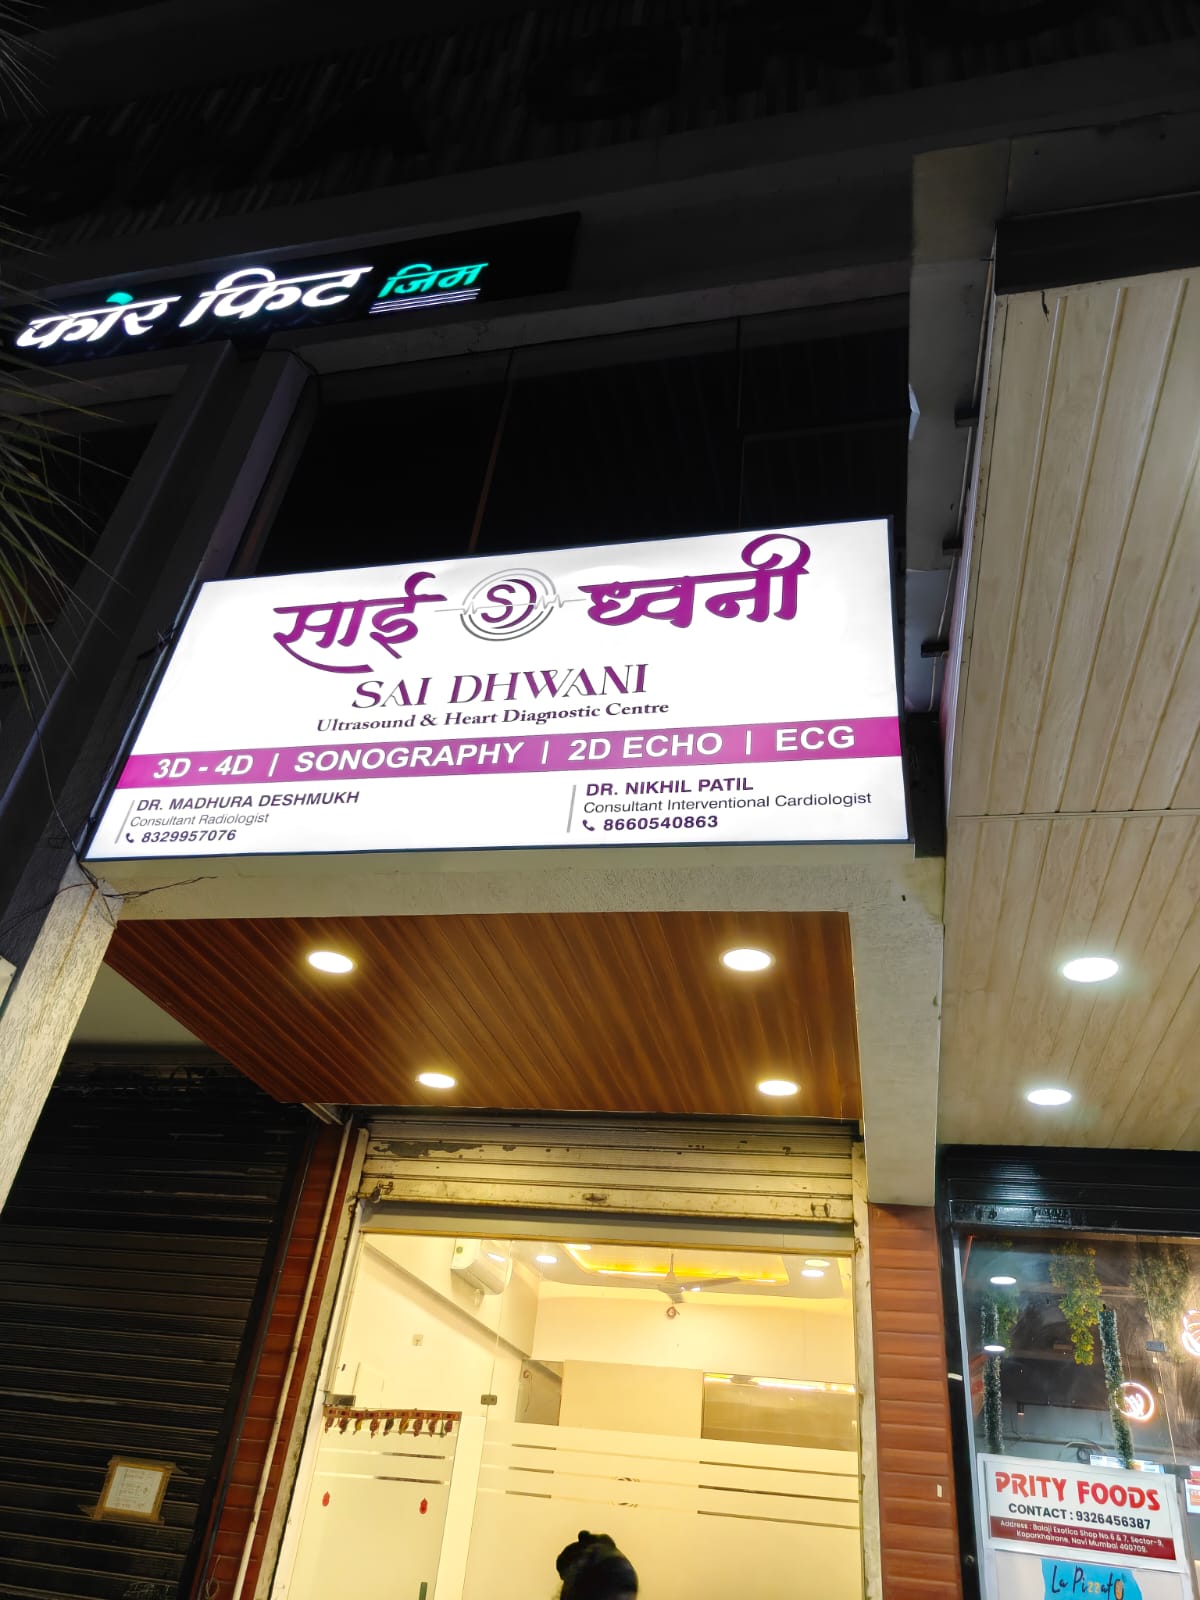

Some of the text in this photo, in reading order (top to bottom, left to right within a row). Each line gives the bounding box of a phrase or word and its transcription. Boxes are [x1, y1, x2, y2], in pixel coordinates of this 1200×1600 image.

[179, 267, 374, 328] फिट
[377, 263, 489, 298] जिम
[578, 533, 812, 629] ध्वनी
[272, 571, 448, 674] साई
[351, 663, 650, 710] SAI DHWANI
[316, 702, 670, 733] Ultrasound & Heart Diagnostic Centre
[153, 757, 191, 780] 3D
[214, 753, 254, 777] 4D
[294, 741, 525, 774] SONOGRAPHY
[567, 738, 613, 763] 2D
[622, 732, 724, 760] ECHO
[775, 725, 857, 753] ECG
[586, 777, 754, 796] DR. NIKHIL PATIL
[136, 791, 360, 812] DR. MADHURA DESHMUKH
[583, 792, 872, 814] Consultant Interventional Cardiologist
[130, 812, 269, 828] Consultant Radiologist
[603, 815, 718, 831] 8660540863
[141, 829, 237, 844] 8329957076
[995, 1471, 1067, 1502] PRITY
[1077, 1480, 1160, 1511] FOODS
[1008, 1503, 1067, 1520] CONTACT
[1076, 1511, 1151, 1530] 9326456387
